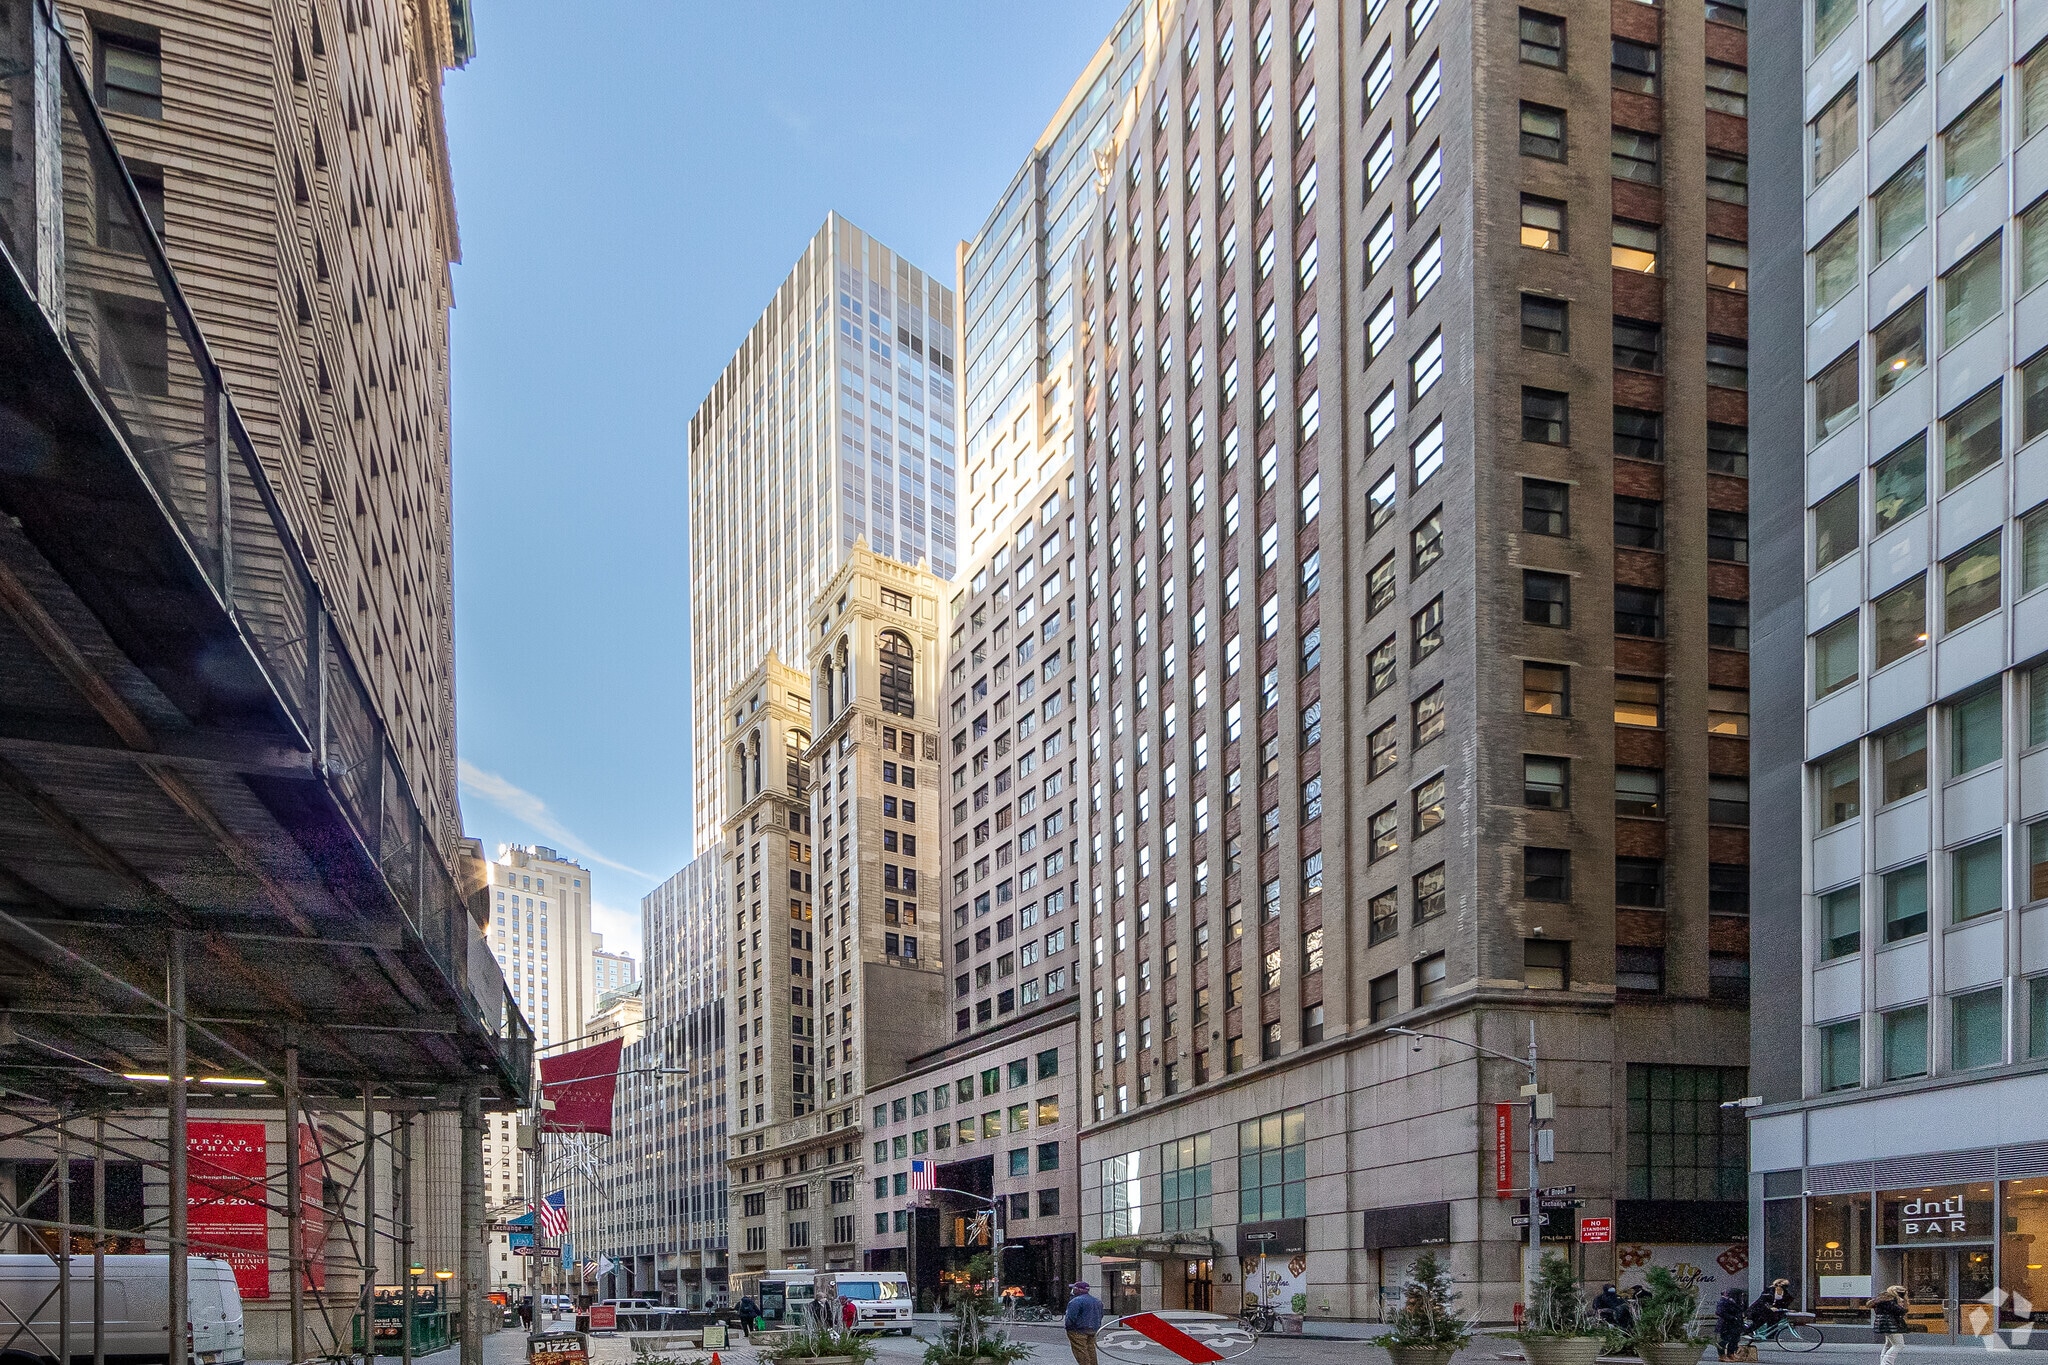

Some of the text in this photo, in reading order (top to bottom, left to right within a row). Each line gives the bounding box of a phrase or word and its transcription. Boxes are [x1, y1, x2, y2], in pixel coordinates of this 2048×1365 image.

[190, 1138, 247, 1146] BROAD
[1541, 1200, 1567, 1209] Exchange
[1904, 1195, 1963, 1216] dntl
[492, 1225, 522, 1233] Exchange
[1905, 1220, 1966, 1235] BAR
[1221, 1273, 1232, 1283] 30
[533, 1340, 582, 1354] Pizza
